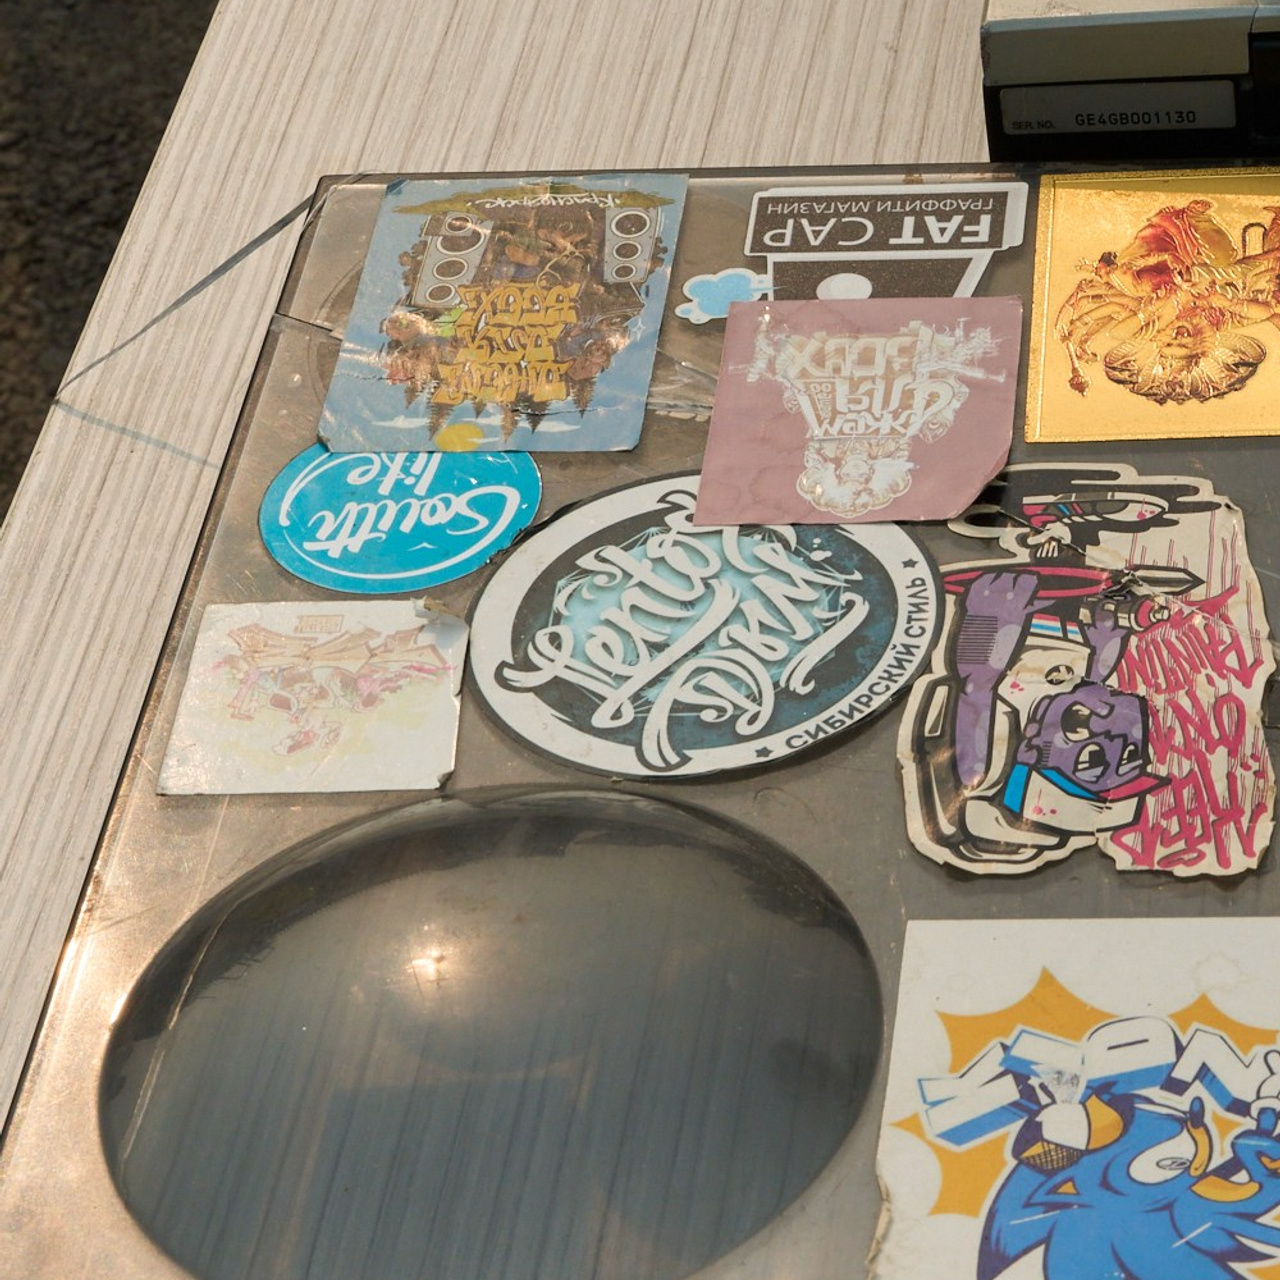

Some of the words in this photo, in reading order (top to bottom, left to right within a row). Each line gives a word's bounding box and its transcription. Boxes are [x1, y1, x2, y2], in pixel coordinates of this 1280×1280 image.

[767, 200, 870, 215] МАГАЗИН
[876, 197, 994, 213] ГРАФФИТИ
[763, 216, 875, 248] CAP
[889, 214, 991, 245] FAT
[303, 486, 512, 558] South
[785, 641, 920, 750] СИБИРСКИЙ
[904, 576, 929, 642] СТИЛЬ
[1110, 749, 1267, 870] KEEP
